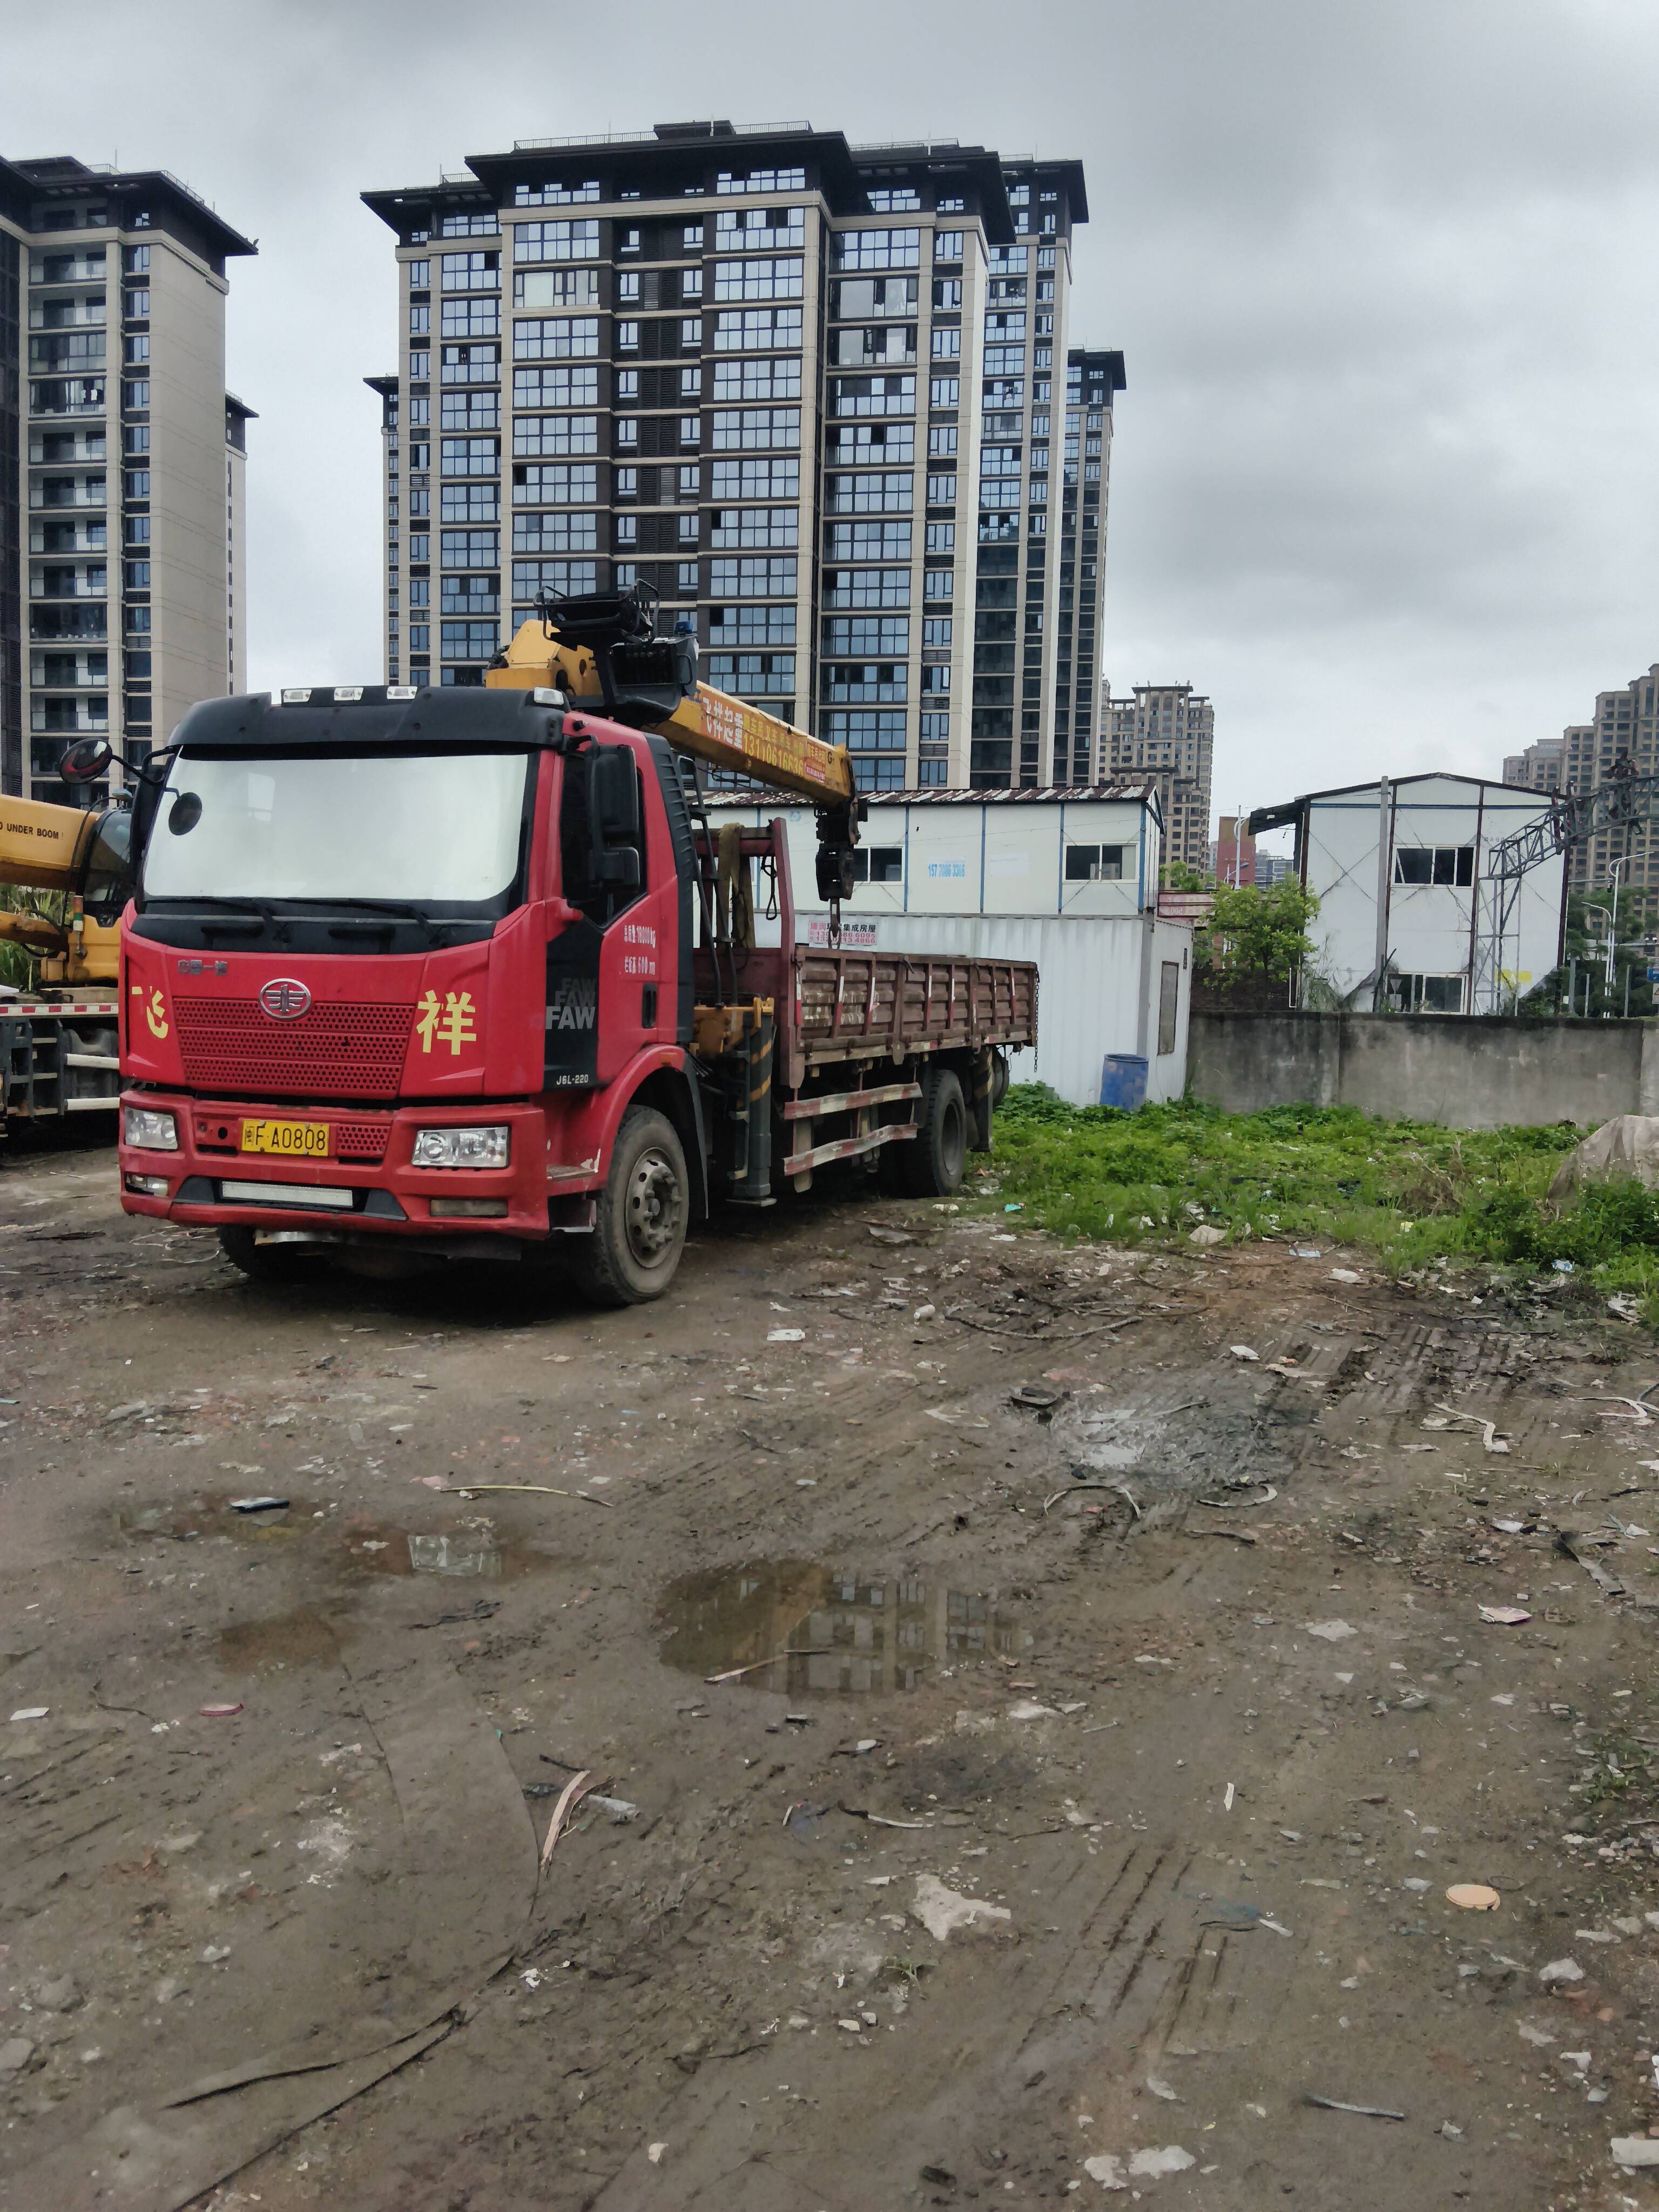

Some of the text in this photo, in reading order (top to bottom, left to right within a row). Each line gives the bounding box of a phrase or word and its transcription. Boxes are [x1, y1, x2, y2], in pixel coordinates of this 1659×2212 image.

[7, 823, 33, 835] UNDER
[416, 990, 476, 1055] 祥
[545, 1006, 596, 1029] FAW
[556, 1074, 589, 1085] J6L-220
